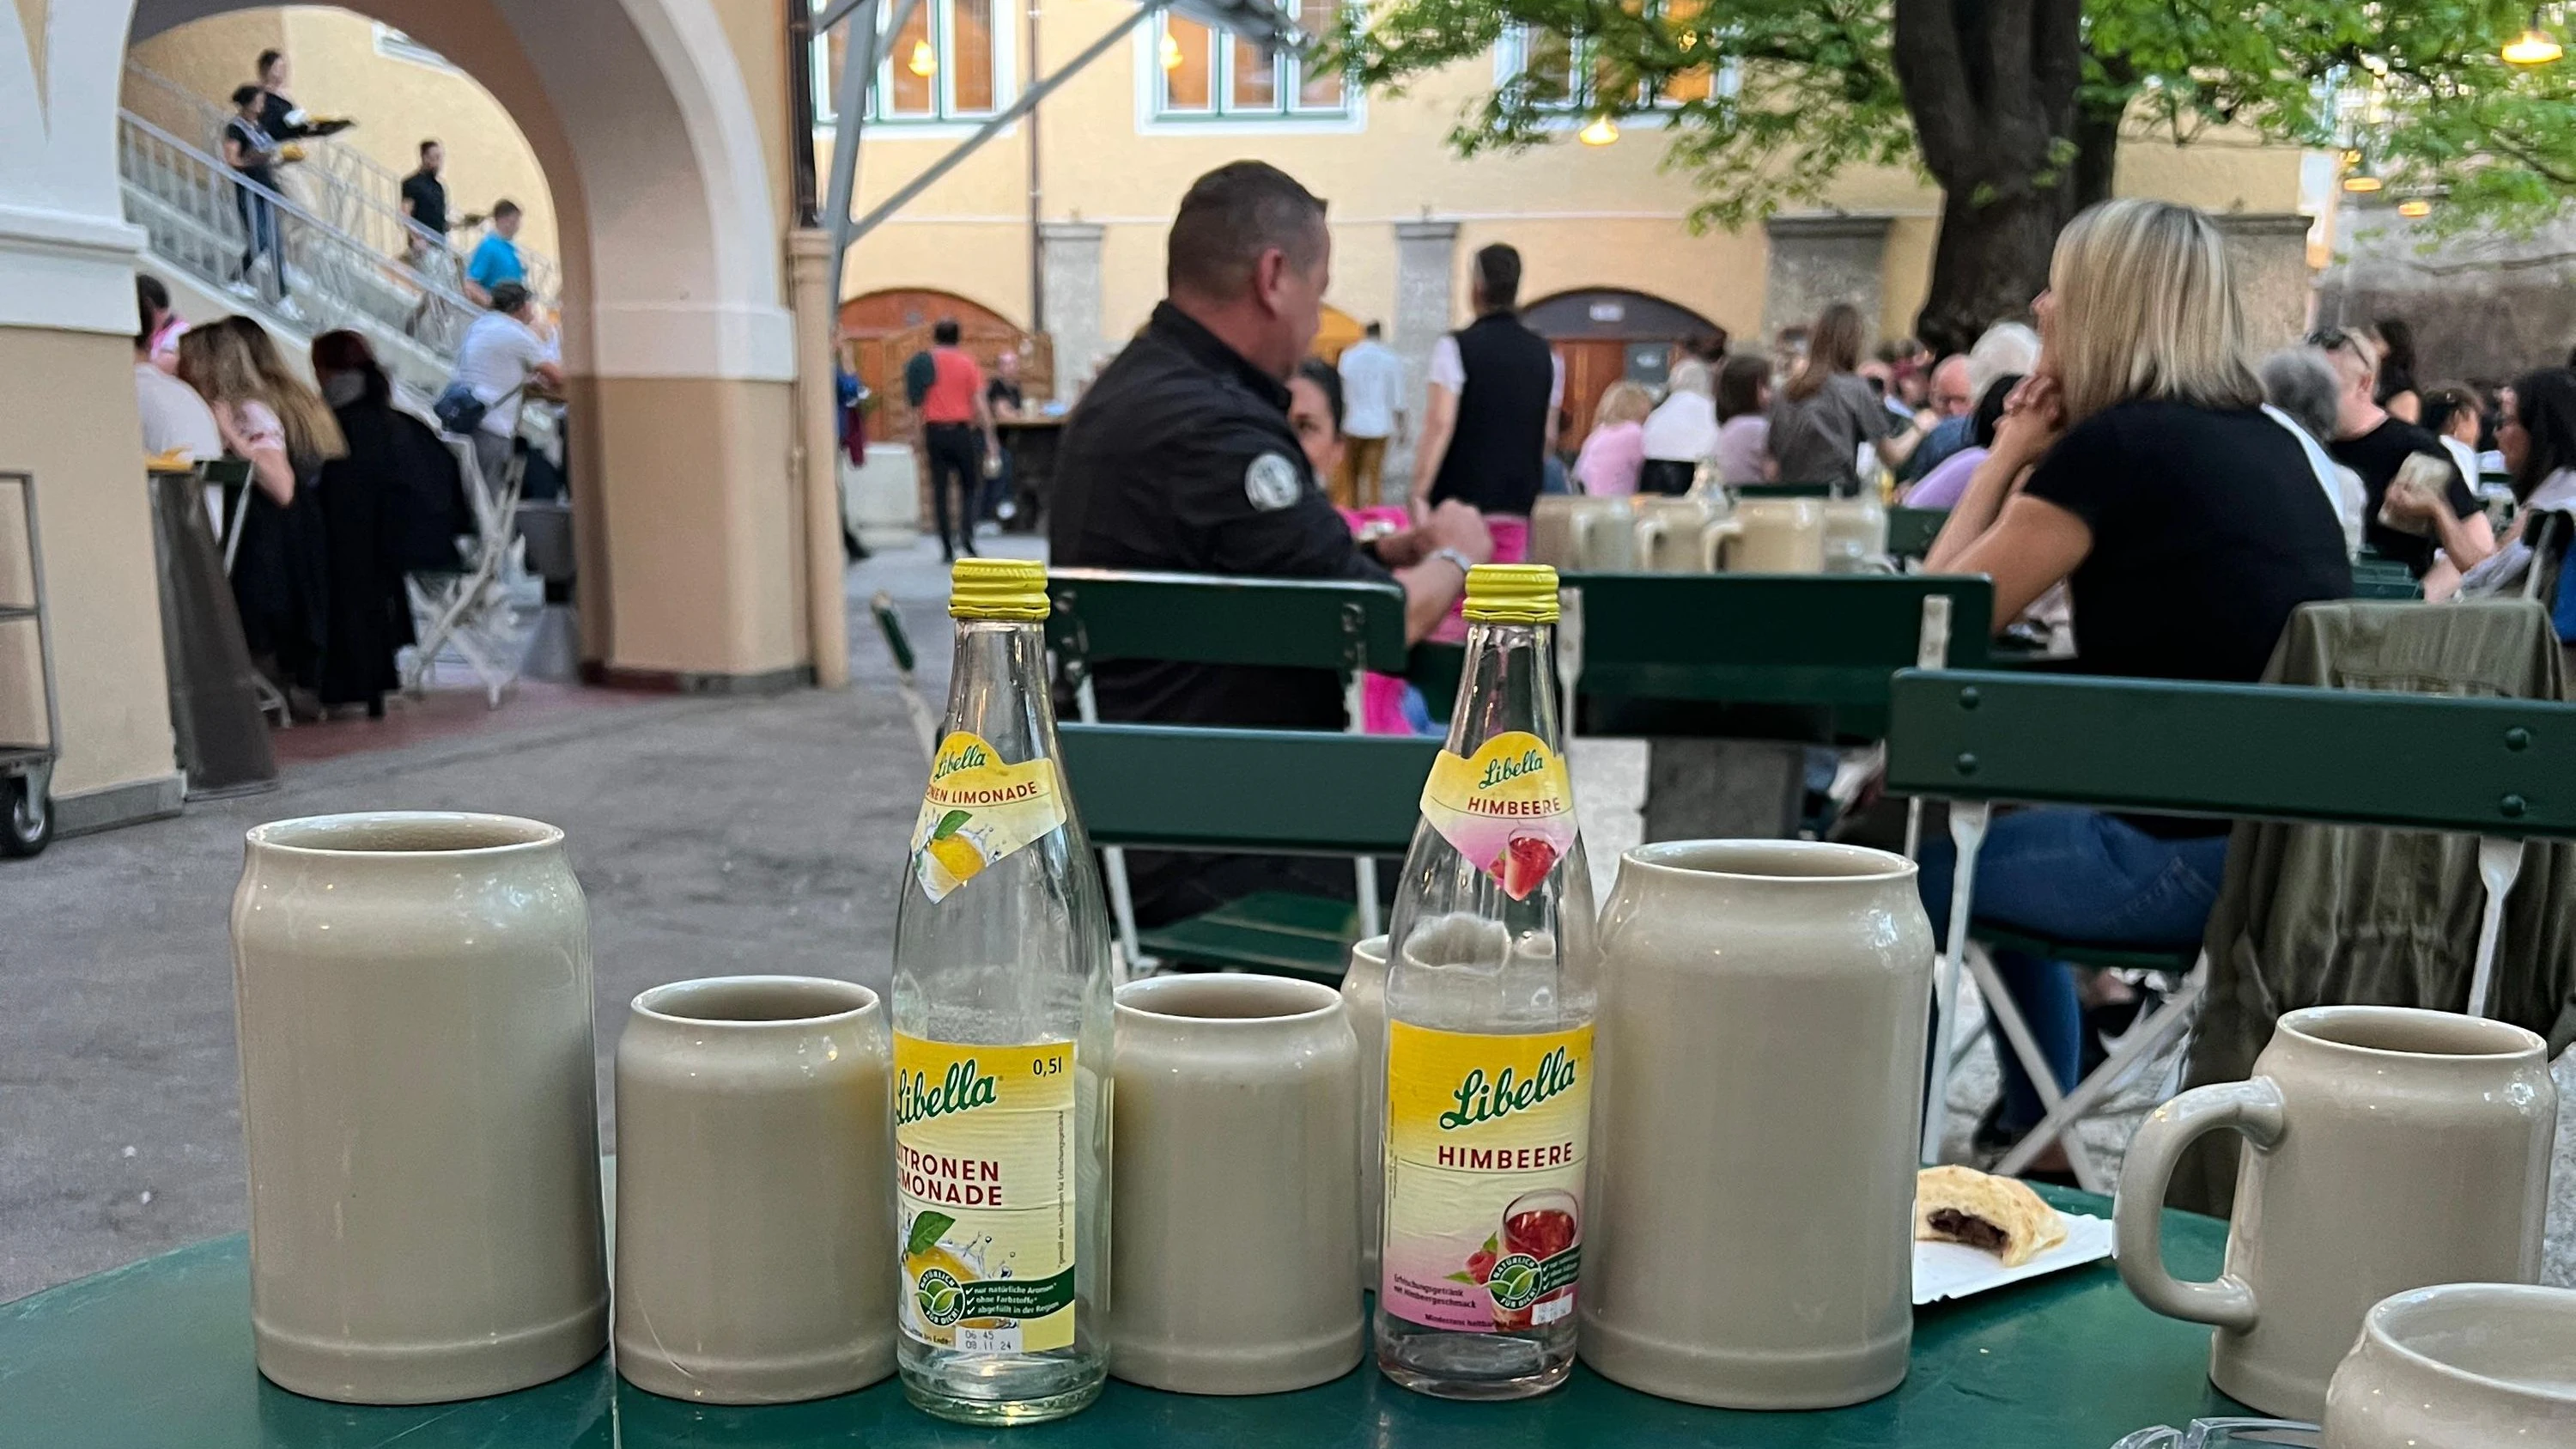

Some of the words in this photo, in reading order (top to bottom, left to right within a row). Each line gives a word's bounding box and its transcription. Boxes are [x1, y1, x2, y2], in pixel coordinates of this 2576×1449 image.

[933, 745, 986, 781] Libella
[1479, 749, 1543, 789] Libella
[951, 781, 1037, 803] LIMONADE
[1467, 797, 1560, 815] HIMBEERE
[896, 1059, 996, 1126] Libella
[1439, 1045, 1576, 1129] Libella
[1438, 1142, 1572, 1169] HIMBEERE
[920, 1270, 955, 1288] NATÜRLICH
[1493, 1257, 1534, 1278] NATÜRLICH
[1500, 1297, 1516, 1308] FÜR
